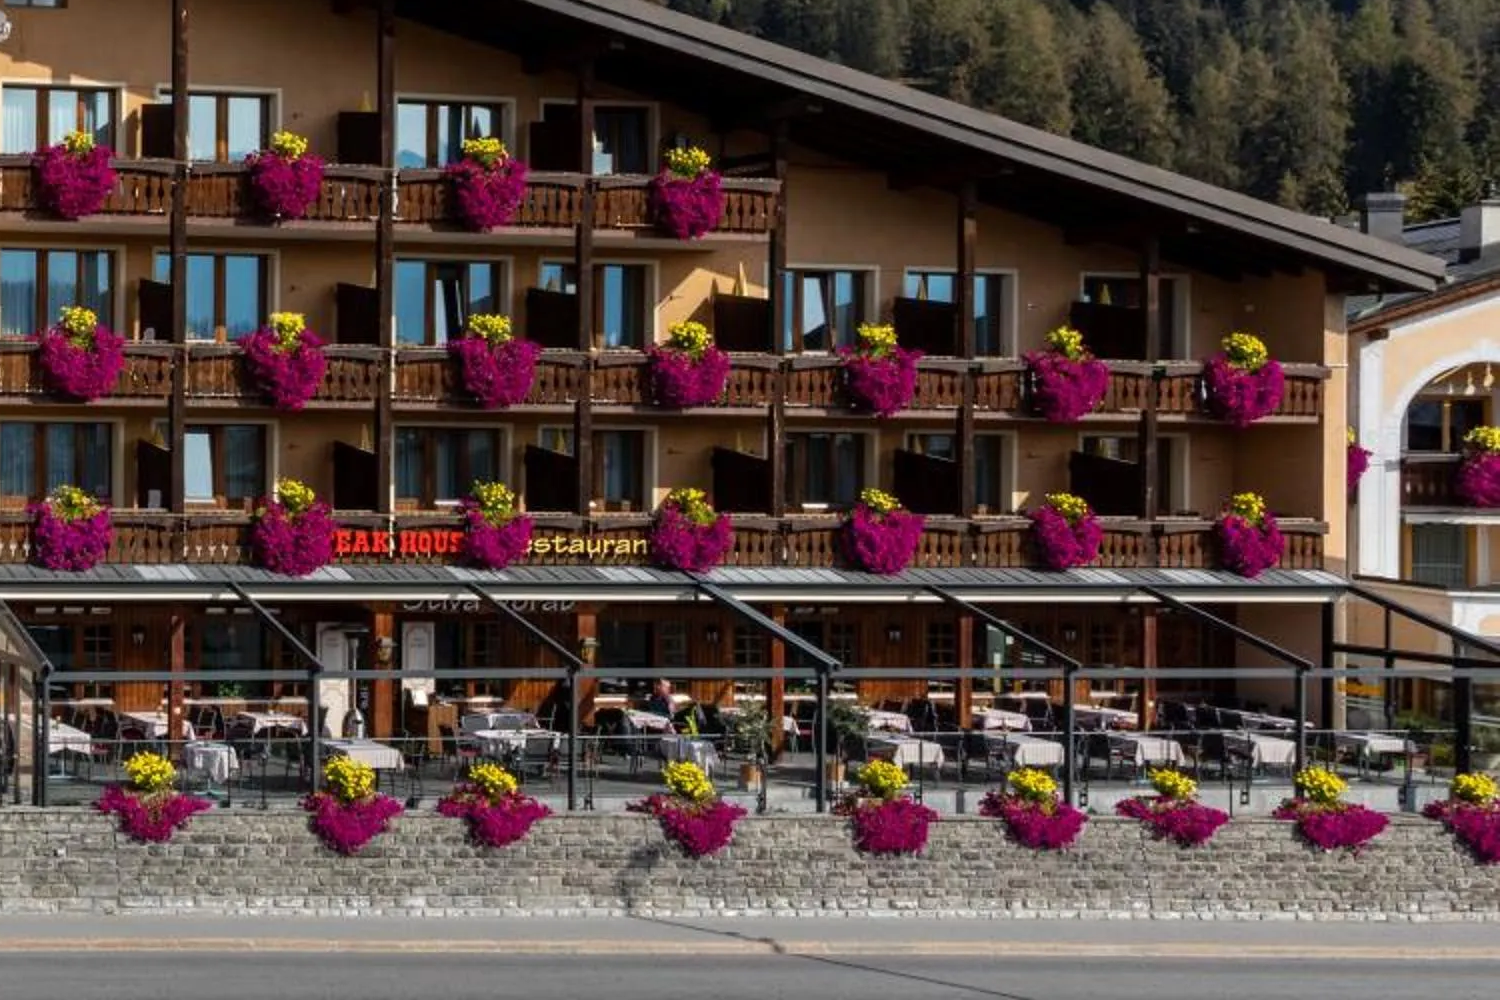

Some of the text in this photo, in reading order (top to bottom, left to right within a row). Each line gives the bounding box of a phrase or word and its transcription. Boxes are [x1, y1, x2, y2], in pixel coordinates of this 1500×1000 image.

[332, 530, 464, 553] EAK HOUS
[526, 536, 649, 555] stauran
